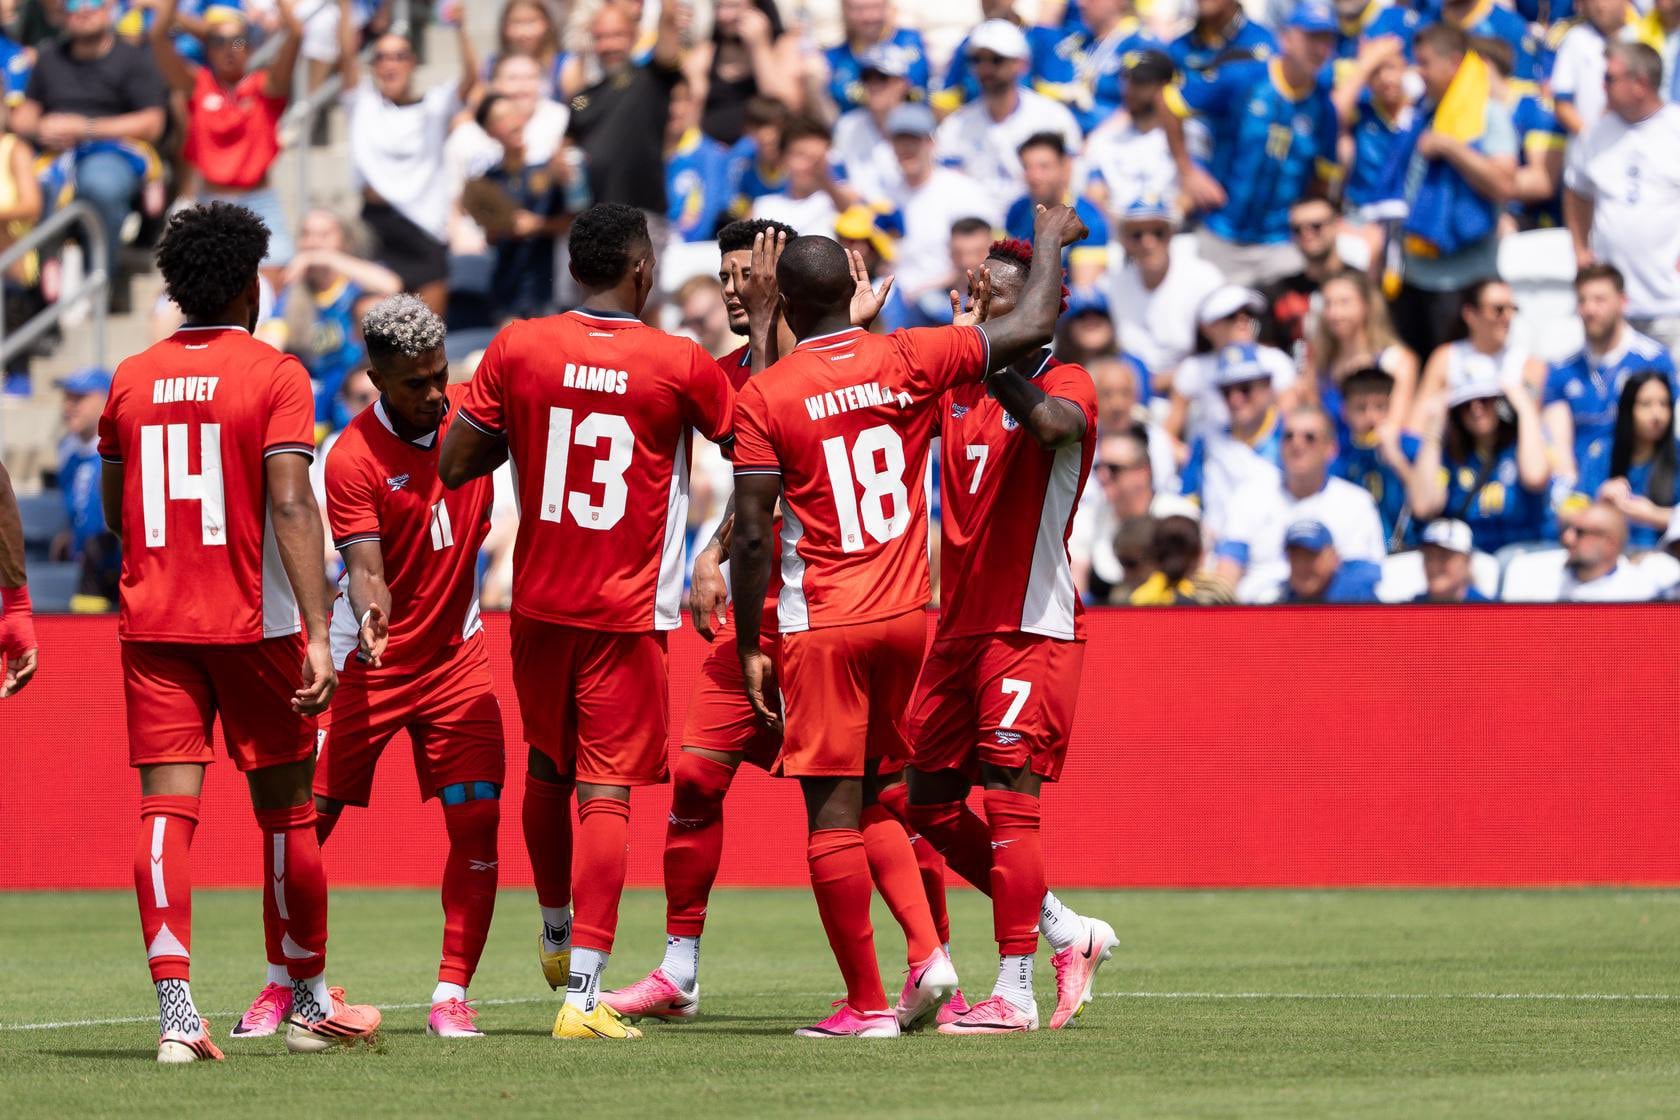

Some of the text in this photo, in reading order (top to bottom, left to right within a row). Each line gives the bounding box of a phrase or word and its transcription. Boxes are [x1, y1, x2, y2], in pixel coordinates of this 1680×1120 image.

[152, 376, 219, 404] HARVEY
[563, 363, 629, 395] RAMOS
[141, 423, 226, 547] 14
[540, 406, 635, 530] 13
[822, 424, 911, 553] 18
[966, 445, 989, 494] 7
[431, 498, 454, 551] 11
[999, 678, 1032, 728] 7
